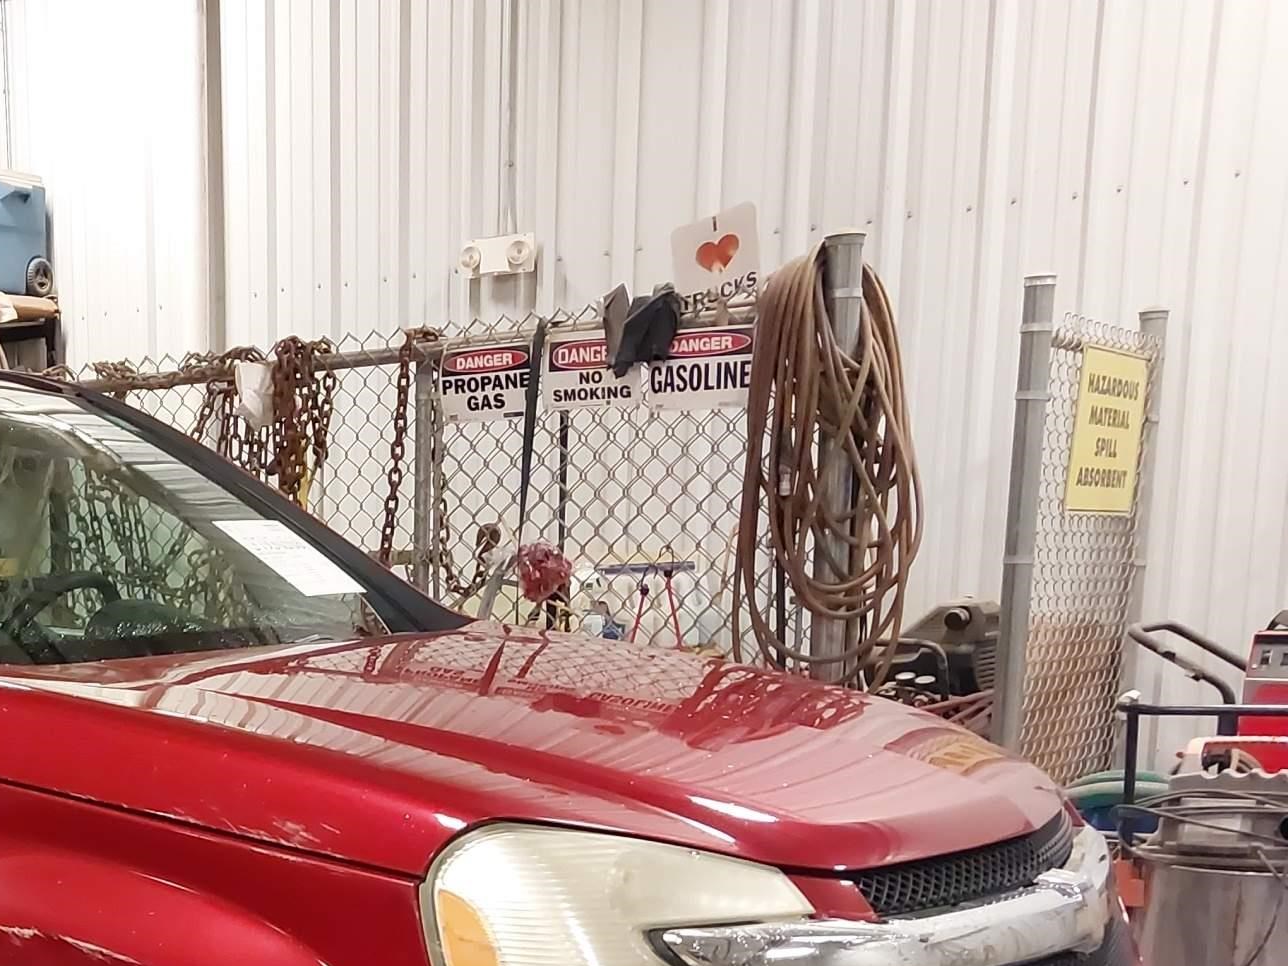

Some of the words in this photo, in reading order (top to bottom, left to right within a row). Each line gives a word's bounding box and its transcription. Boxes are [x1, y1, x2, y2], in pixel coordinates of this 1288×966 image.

[456, 354, 512, 370] DANGER
[442, 371, 530, 395] PROPANE
[579, 371, 602, 384] NO
[650, 360, 751, 394] GASOLINE
[1087, 373, 1140, 400] HAZARDOUS
[467, 393, 506, 411] GAS
[553, 385, 631, 402] SMOKING
[1088, 405, 1130, 429] MATERIAL
[1094, 437, 1117, 457] SPILL
[1075, 467, 1128, 488] ABSORBENT
